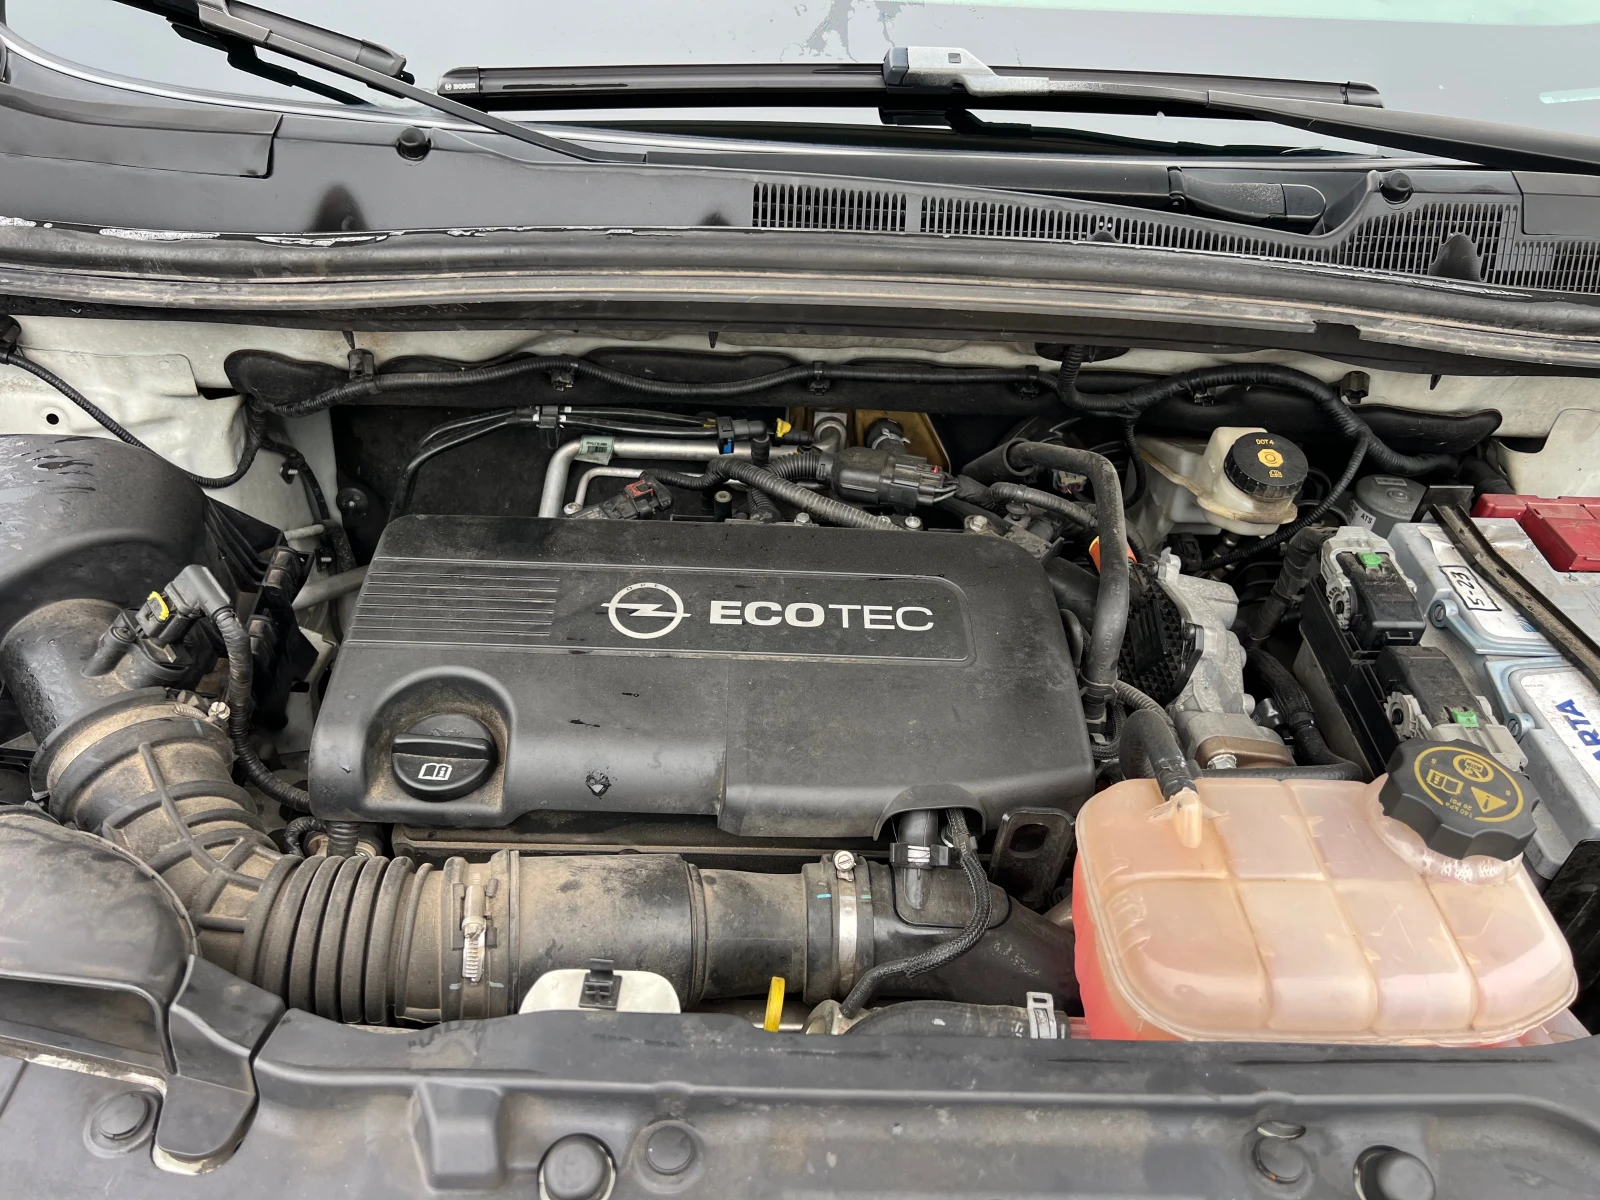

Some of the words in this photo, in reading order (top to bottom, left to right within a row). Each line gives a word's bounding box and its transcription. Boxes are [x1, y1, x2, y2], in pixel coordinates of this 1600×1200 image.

[1361, 513, 1373, 525] ATS
[626, 582, 670, 593] OPEL
[709, 600, 935, 632] ECOTEC
[1555, 699, 1600, 761] RTA
[1460, 808, 1473, 818] 140
